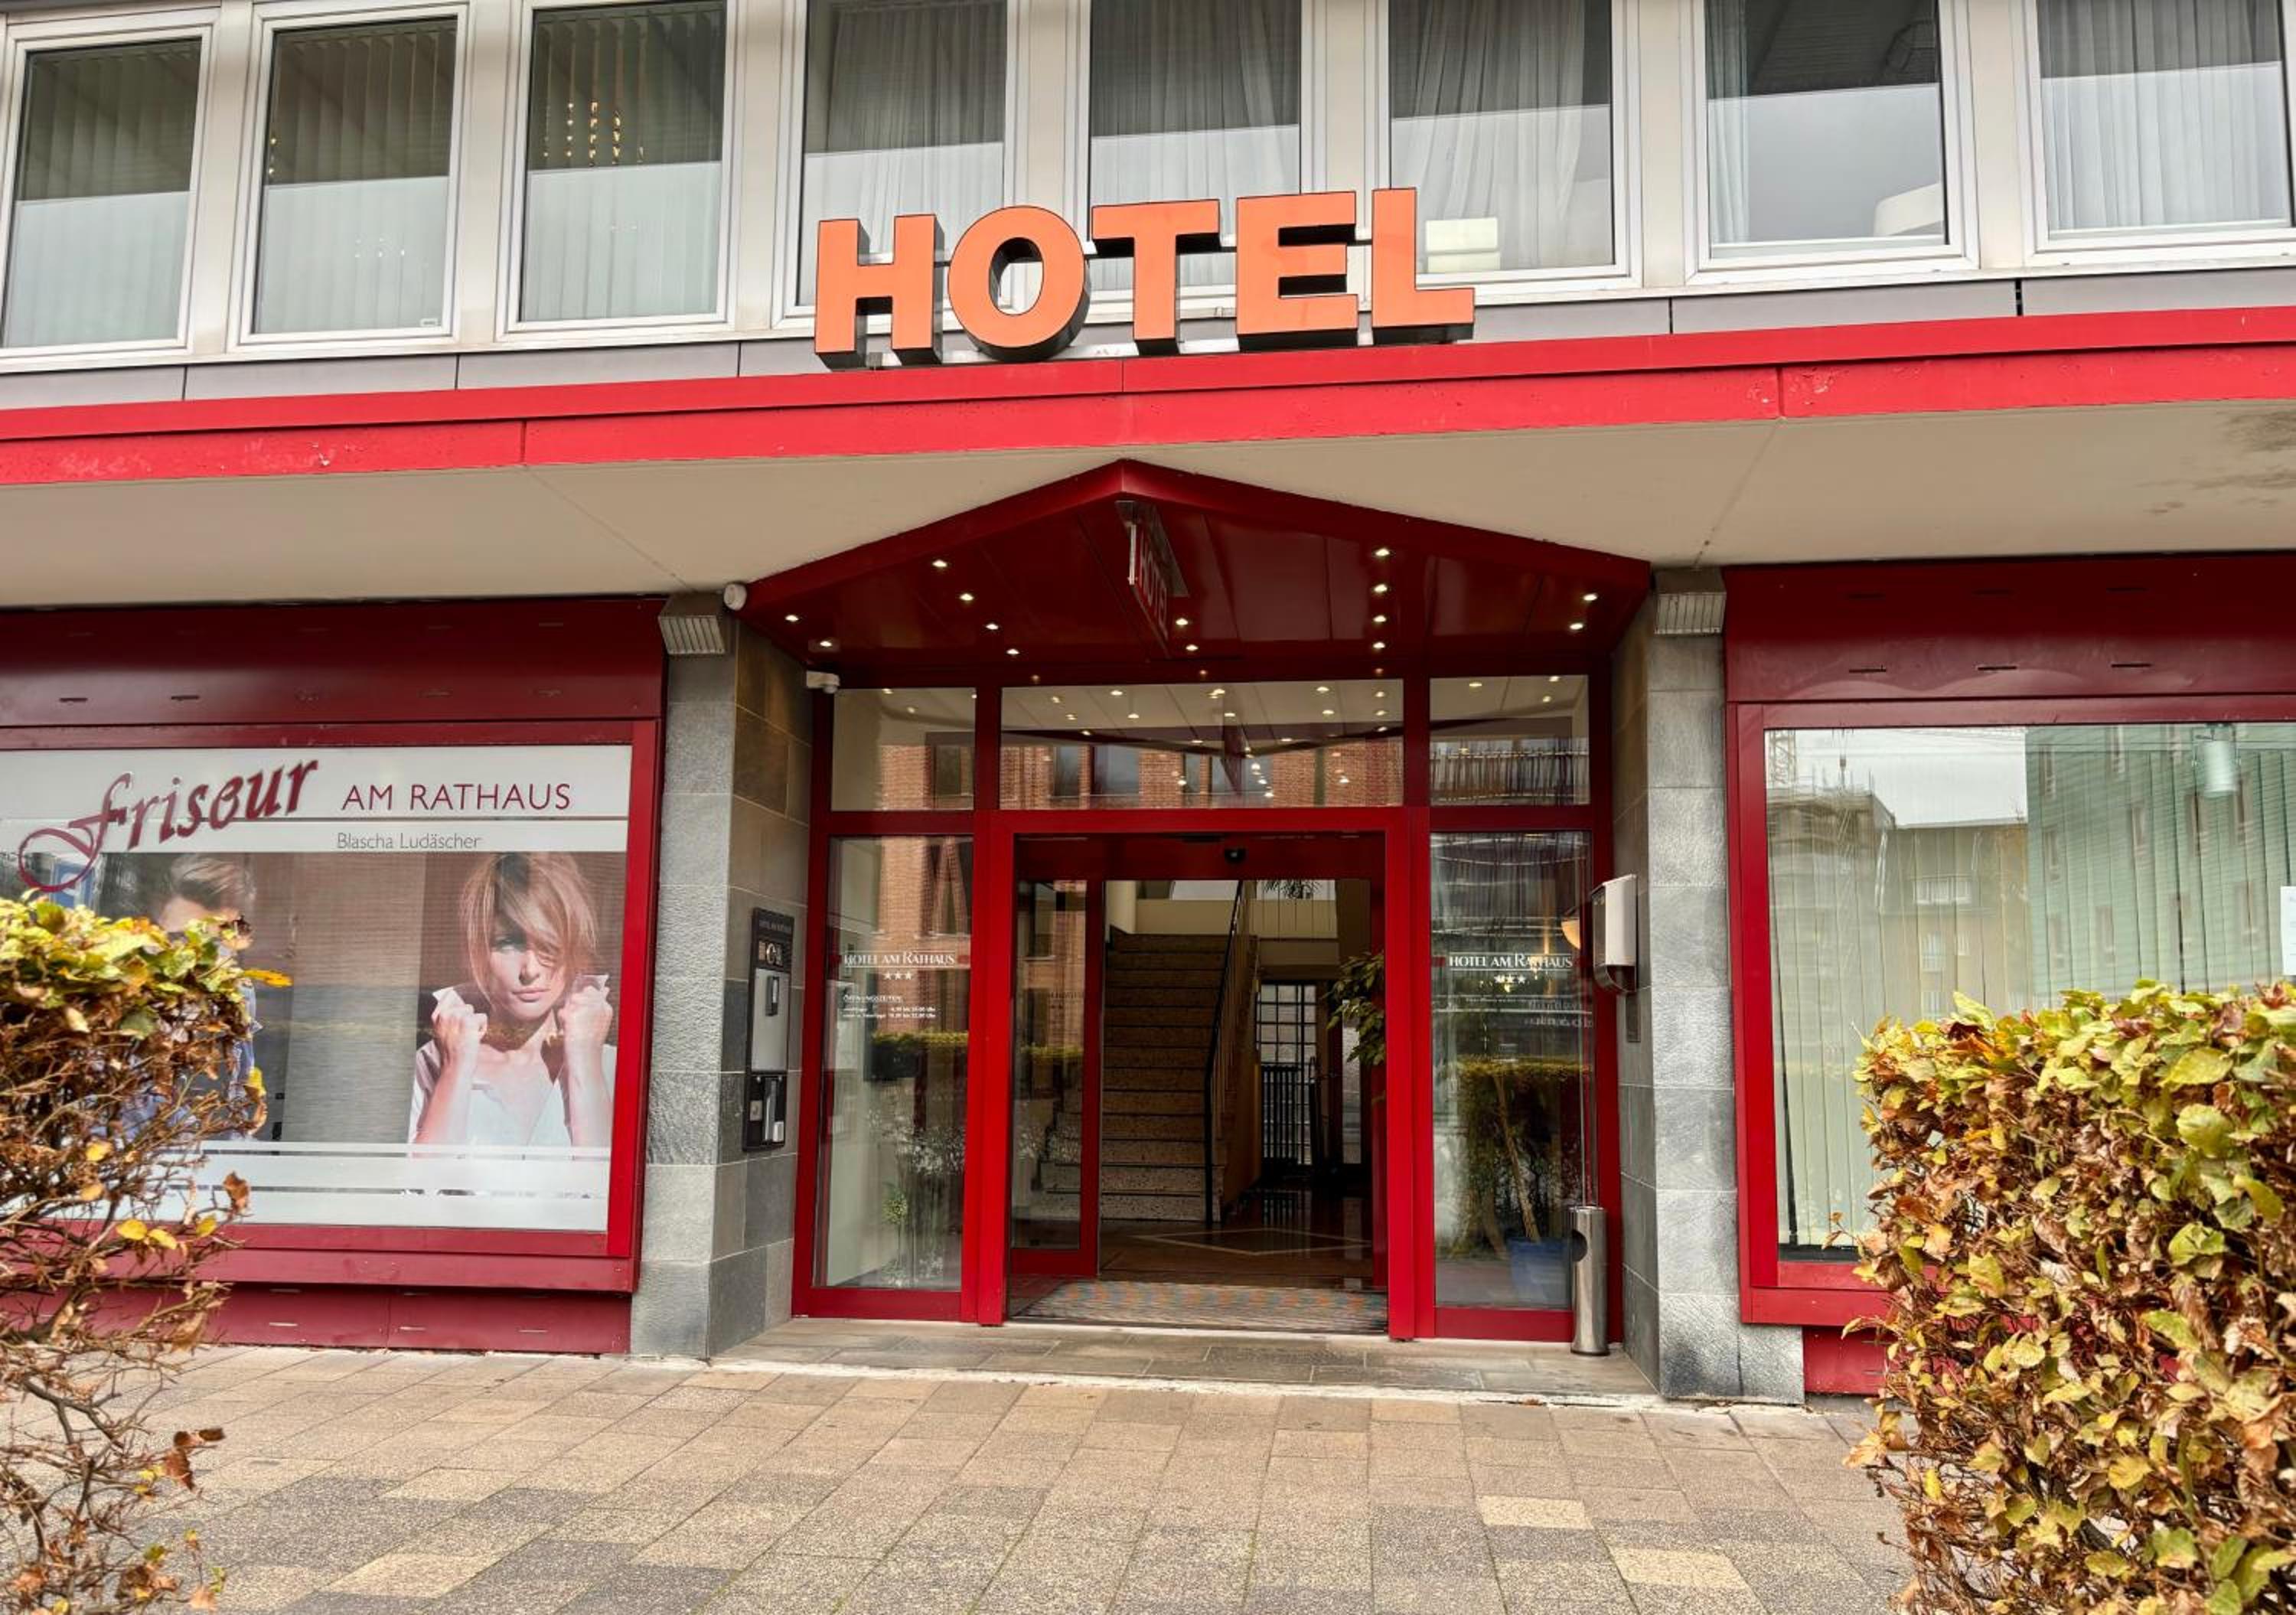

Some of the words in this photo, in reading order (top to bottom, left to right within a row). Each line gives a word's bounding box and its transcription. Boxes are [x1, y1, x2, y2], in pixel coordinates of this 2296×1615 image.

[814, 188, 1476, 361] HOTEL
[341, 783, 393, 811] AM
[409, 783, 572, 811] RATHAUS
[337, 831, 394, 850] Blascha
[400, 831, 484, 850] Ludäscher
[843, 954, 878, 966] HOTEL
[881, 954, 901, 965] AM
[902, 951, 956, 967] RATHAUS
[1449, 955, 1488, 967] HOTEL
[1490, 955, 1514, 968] AM
